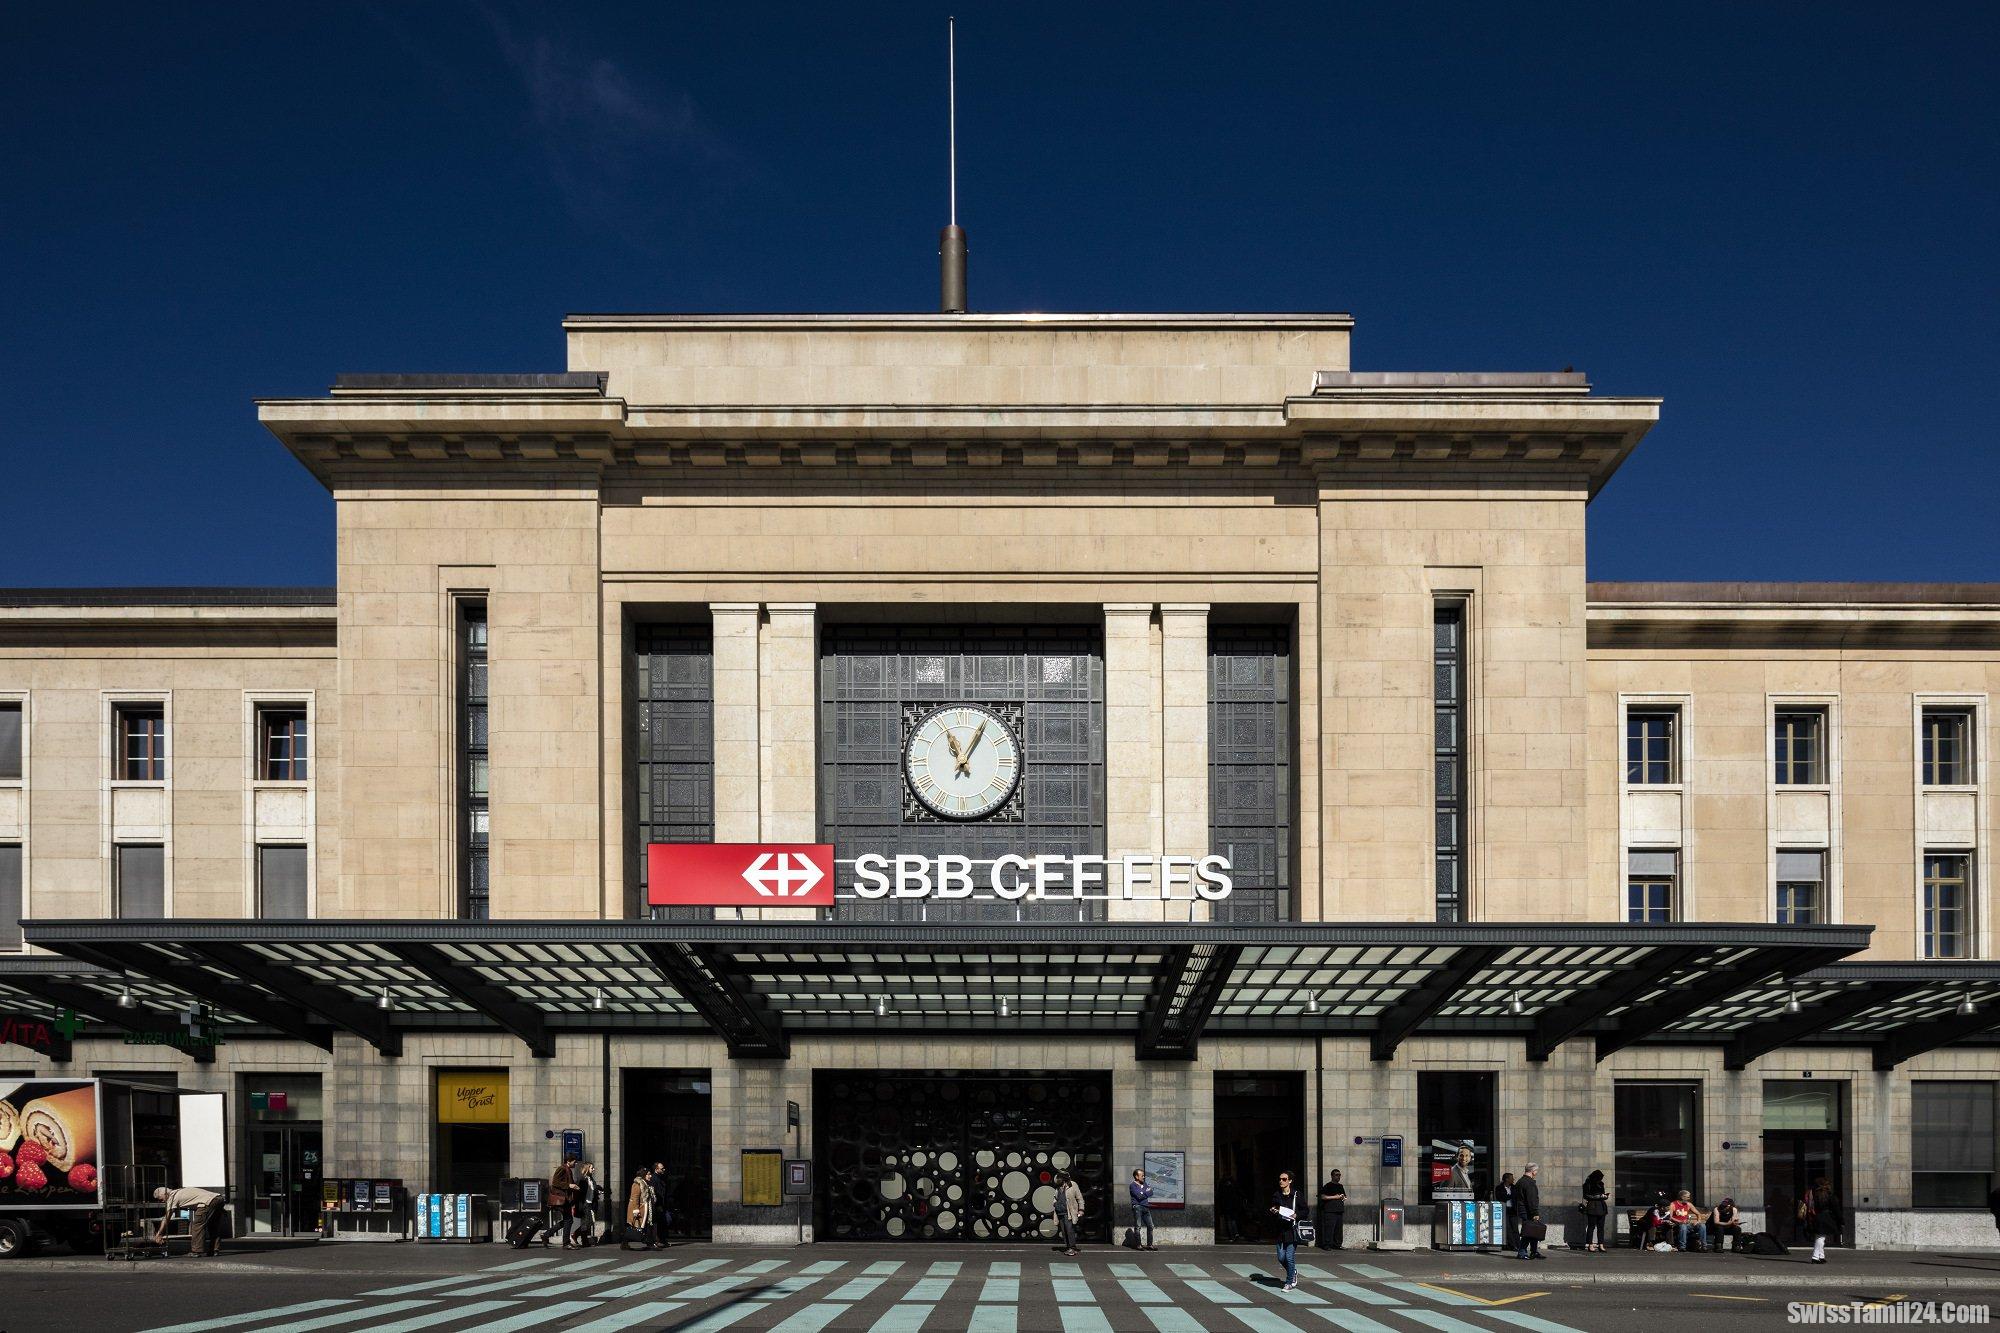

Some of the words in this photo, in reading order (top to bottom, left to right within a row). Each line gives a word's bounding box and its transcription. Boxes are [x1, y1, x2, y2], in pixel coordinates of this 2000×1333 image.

[854, 853, 974, 898] SBB
[990, 854, 1103, 900] CFF
[1123, 855, 1233, 900] FFS
[457, 1086, 488, 1100] Upper
[468, 1094, 495, 1109] Crust
